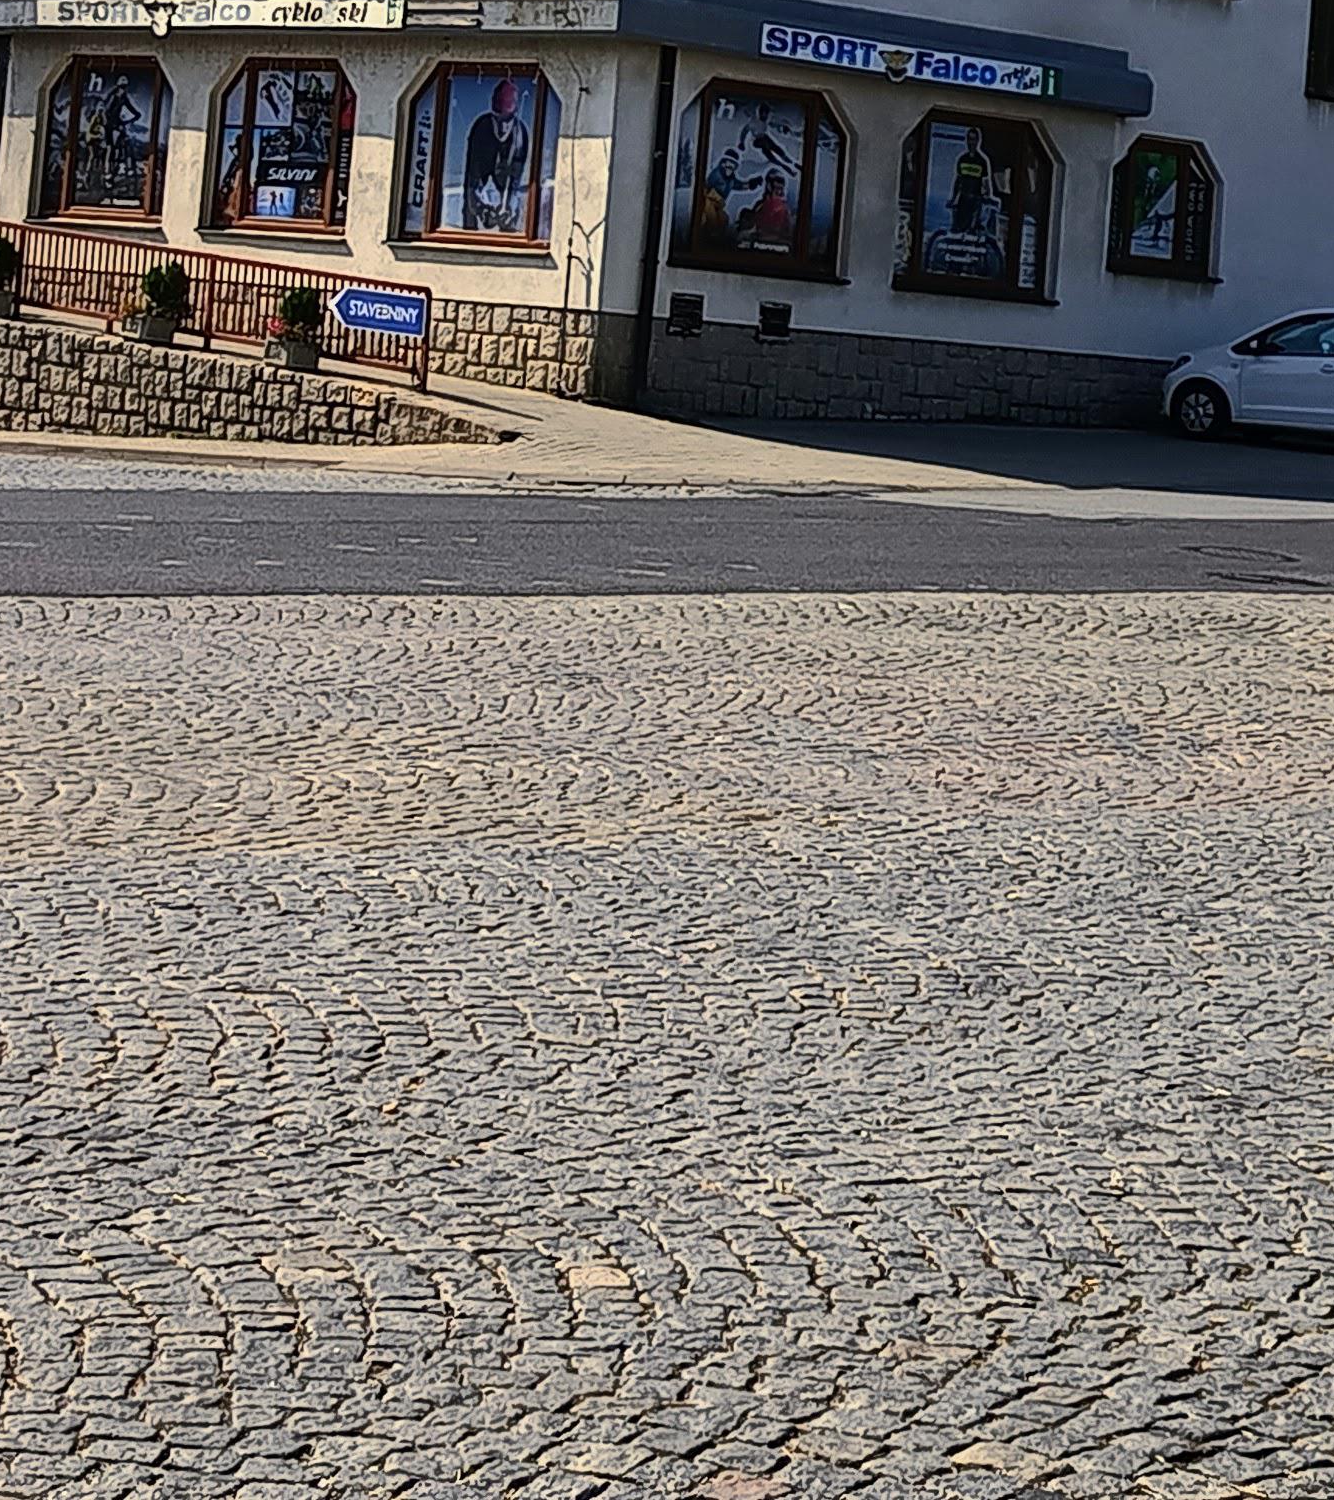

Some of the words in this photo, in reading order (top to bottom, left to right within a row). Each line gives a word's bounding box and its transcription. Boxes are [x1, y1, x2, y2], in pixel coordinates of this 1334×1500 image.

[271, 2, 323, 24] cyklo
[766, 26, 878, 68] SPORT
[913, 51, 998, 86] Falco
[88, 72, 103, 92] h
[411, 130, 431, 208] CRAFT
